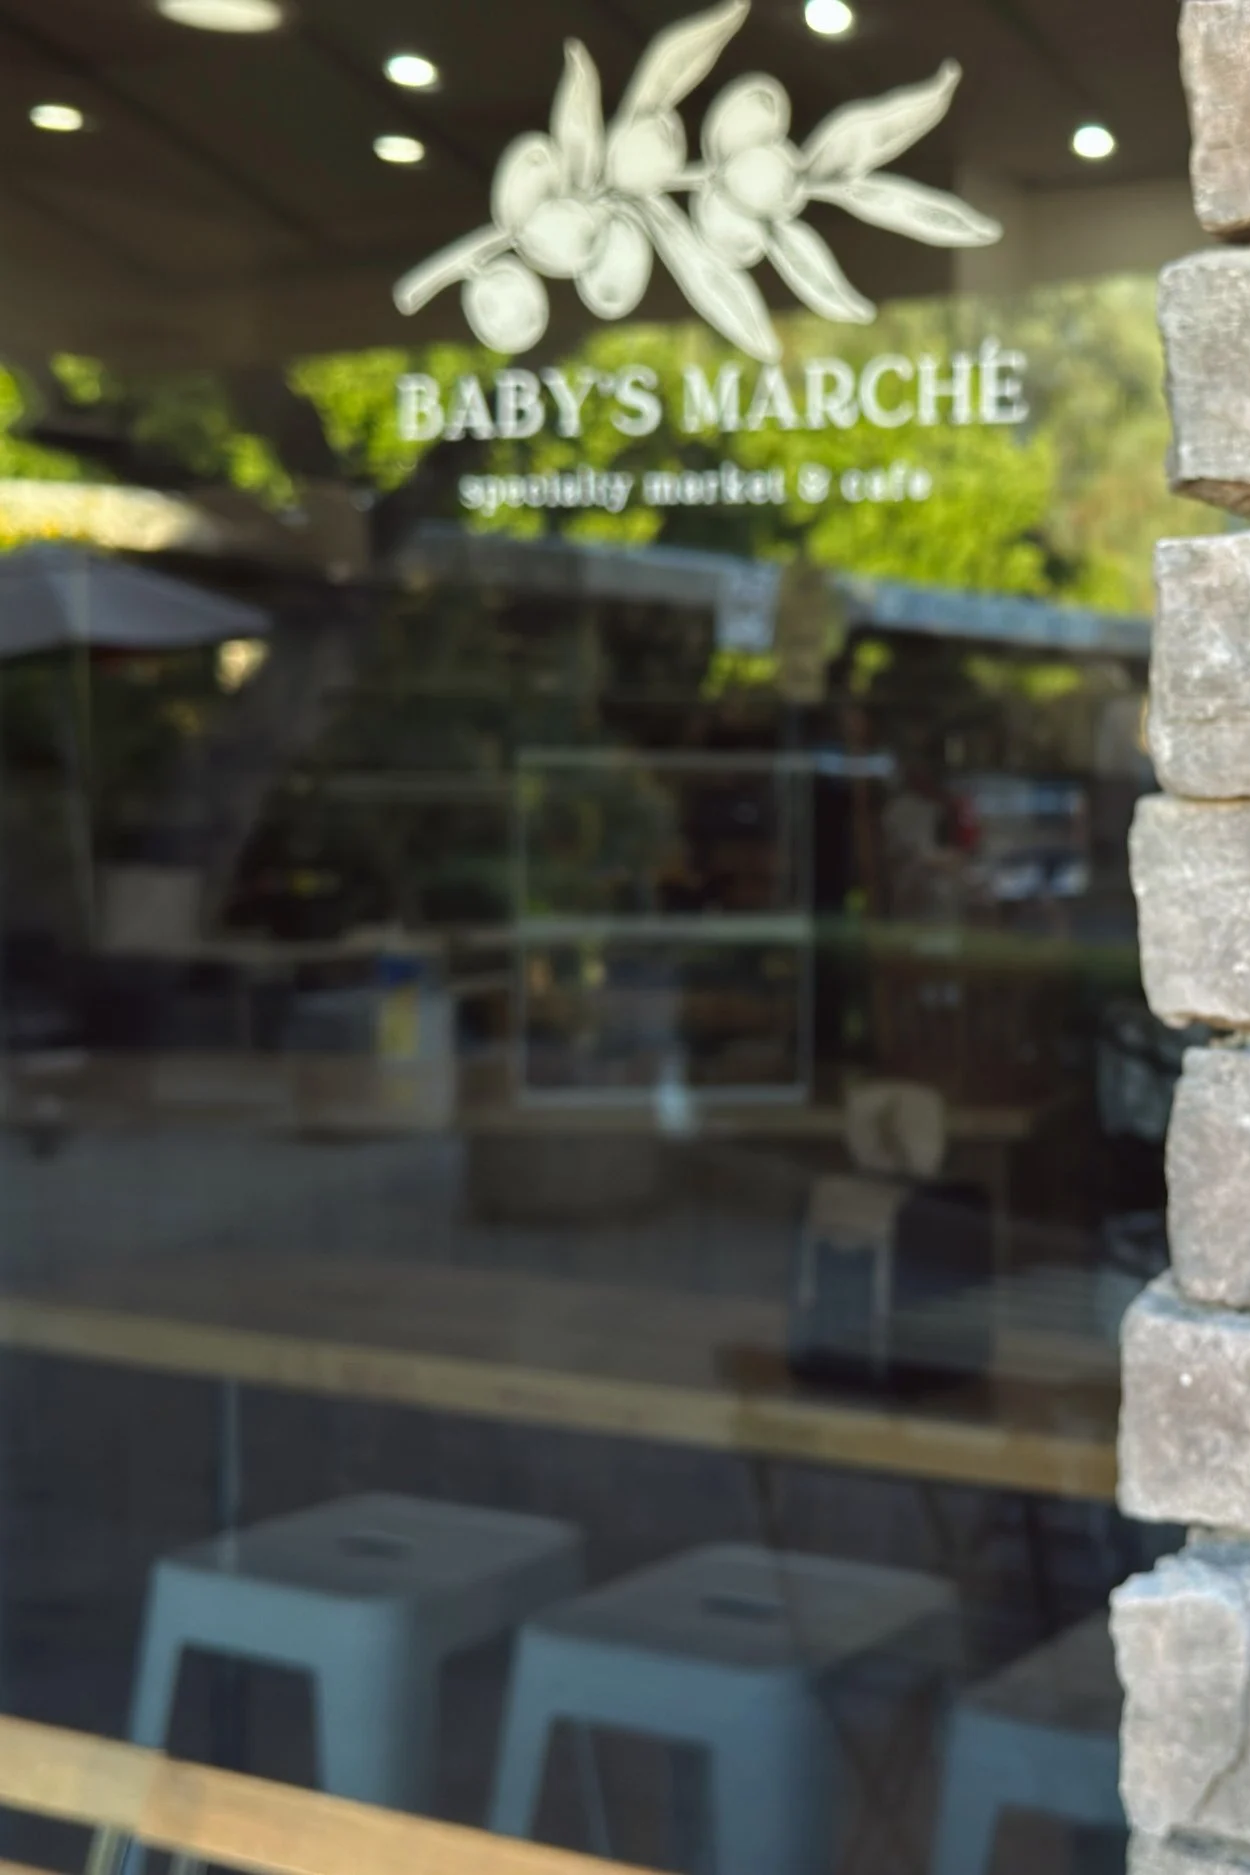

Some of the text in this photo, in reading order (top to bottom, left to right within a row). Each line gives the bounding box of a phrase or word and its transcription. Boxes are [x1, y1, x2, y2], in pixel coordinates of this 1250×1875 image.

[397, 337, 1029, 441] BABY'S MARCHÉ
[458, 464, 634, 515] specialty
[643, 461, 786, 507] market
[797, 463, 830, 504] &
